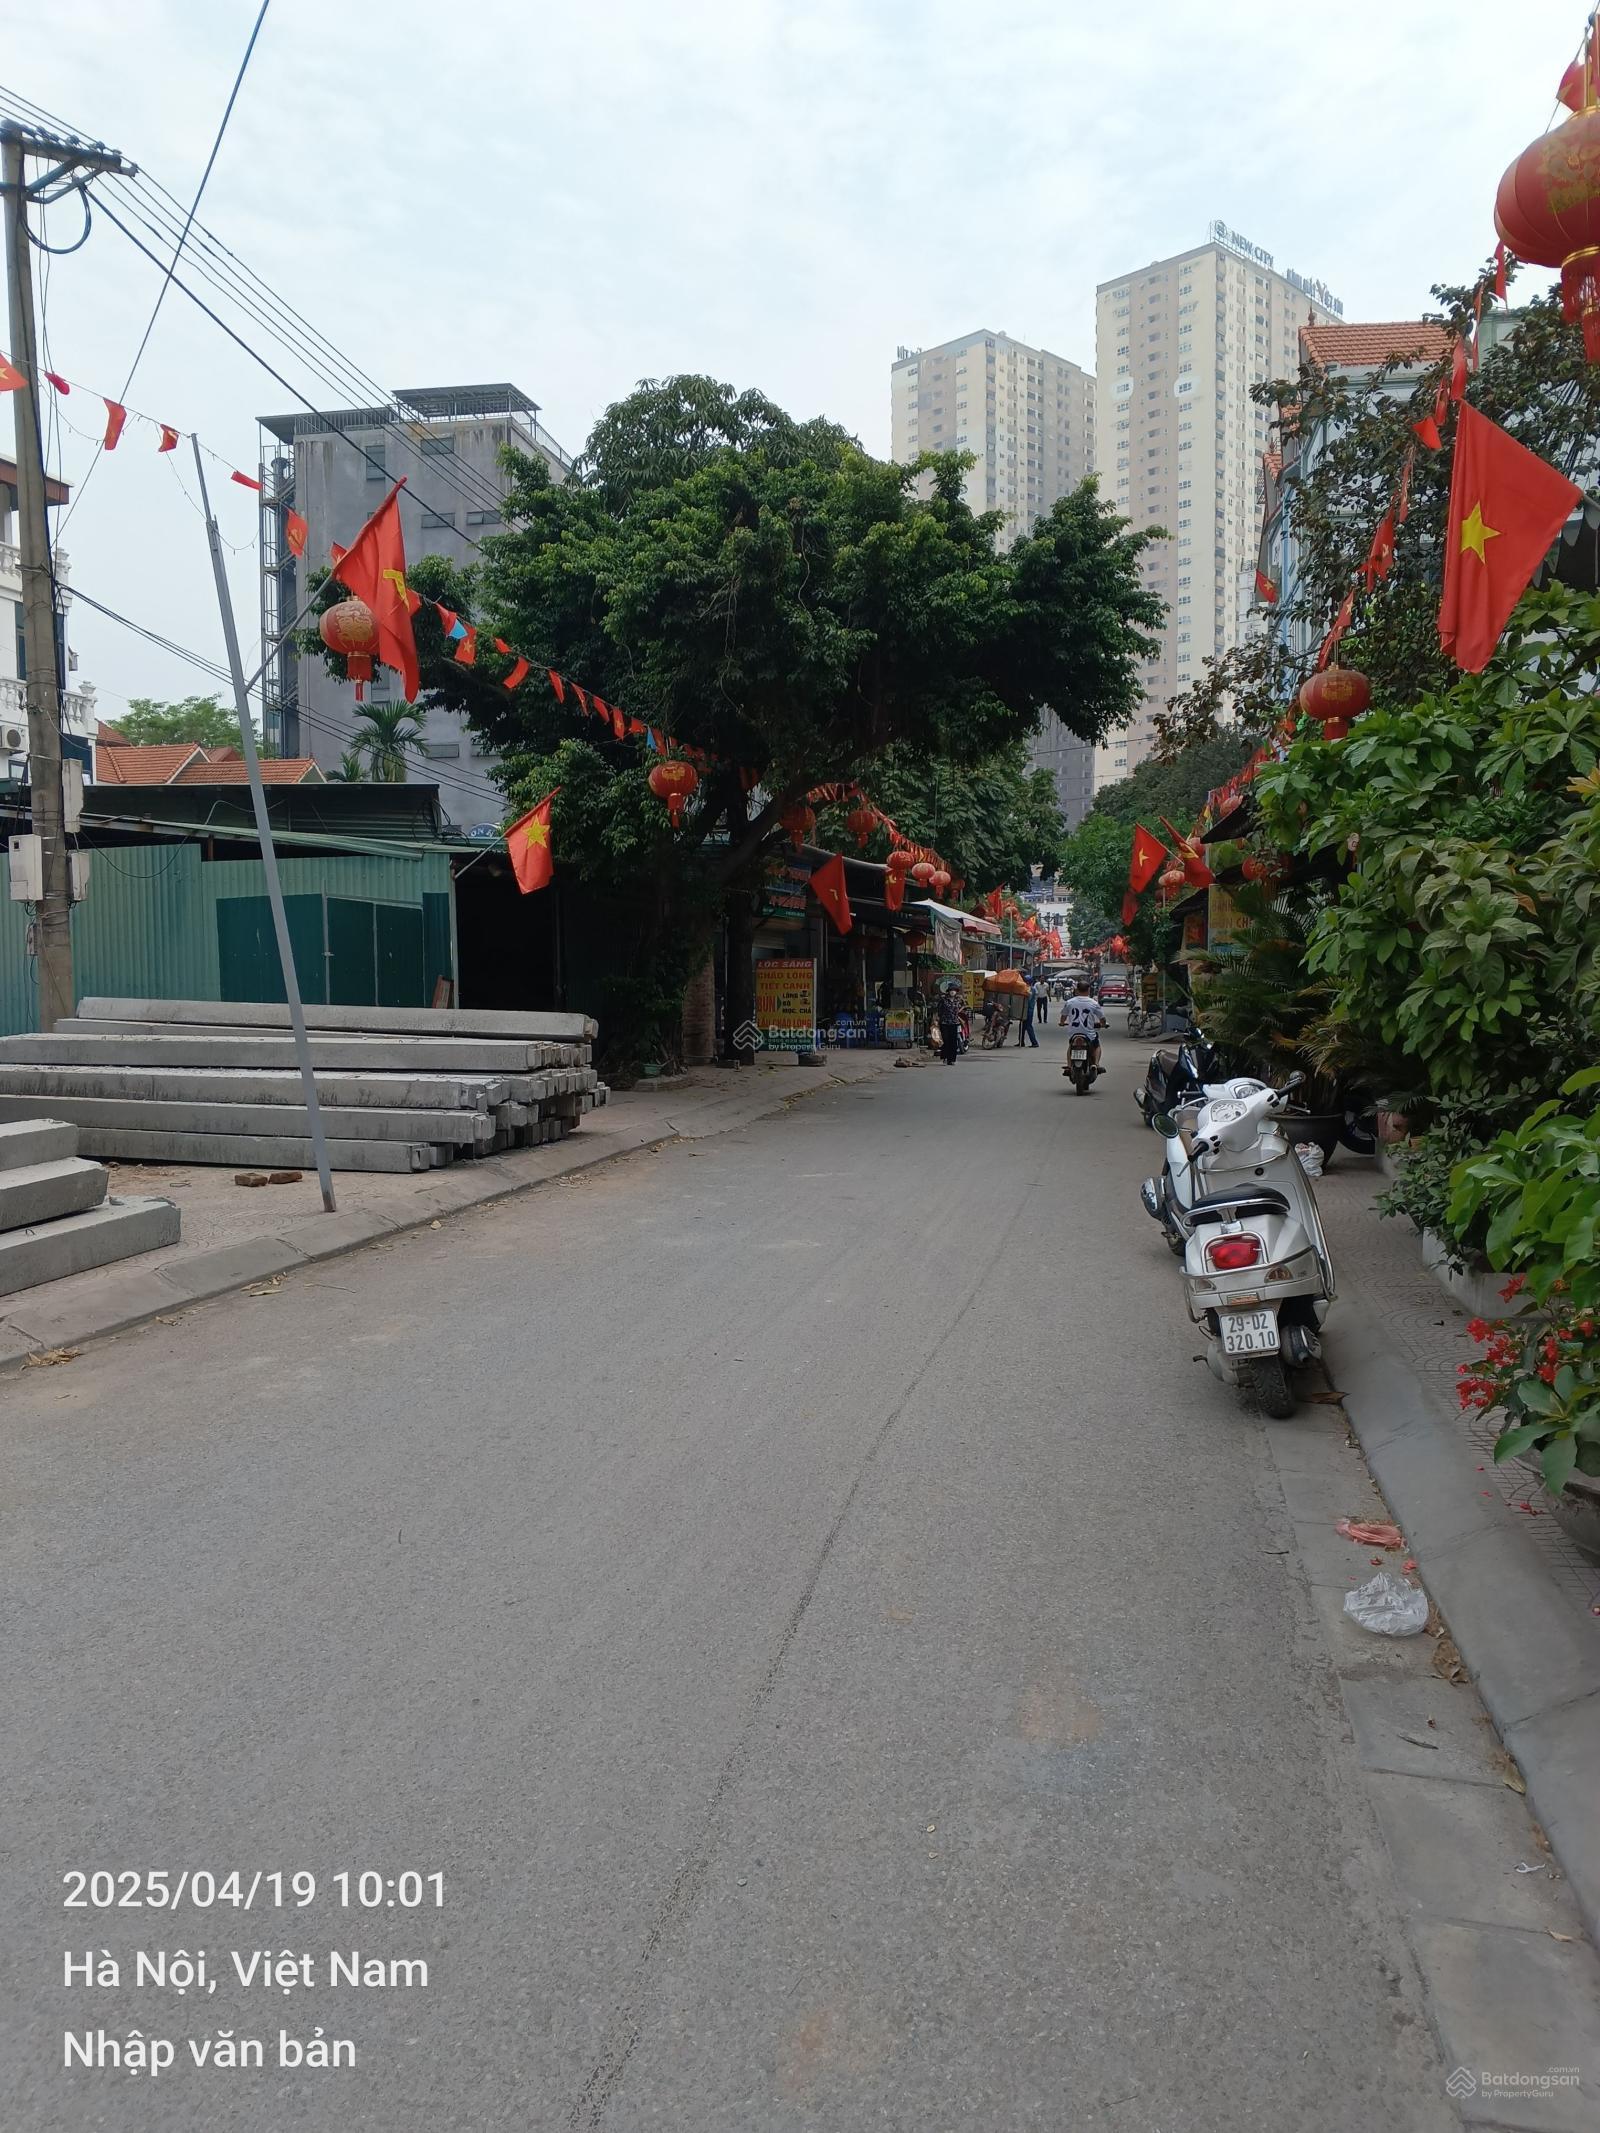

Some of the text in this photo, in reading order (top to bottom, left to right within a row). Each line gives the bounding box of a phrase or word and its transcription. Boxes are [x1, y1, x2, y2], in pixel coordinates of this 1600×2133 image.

[1231, 230, 1274, 267] NEW CITY
[1071, 1008, 1090, 1028] 27
[1228, 1313, 1268, 1333] 29-D2
[1226, 1330, 1276, 1351] 320.10
